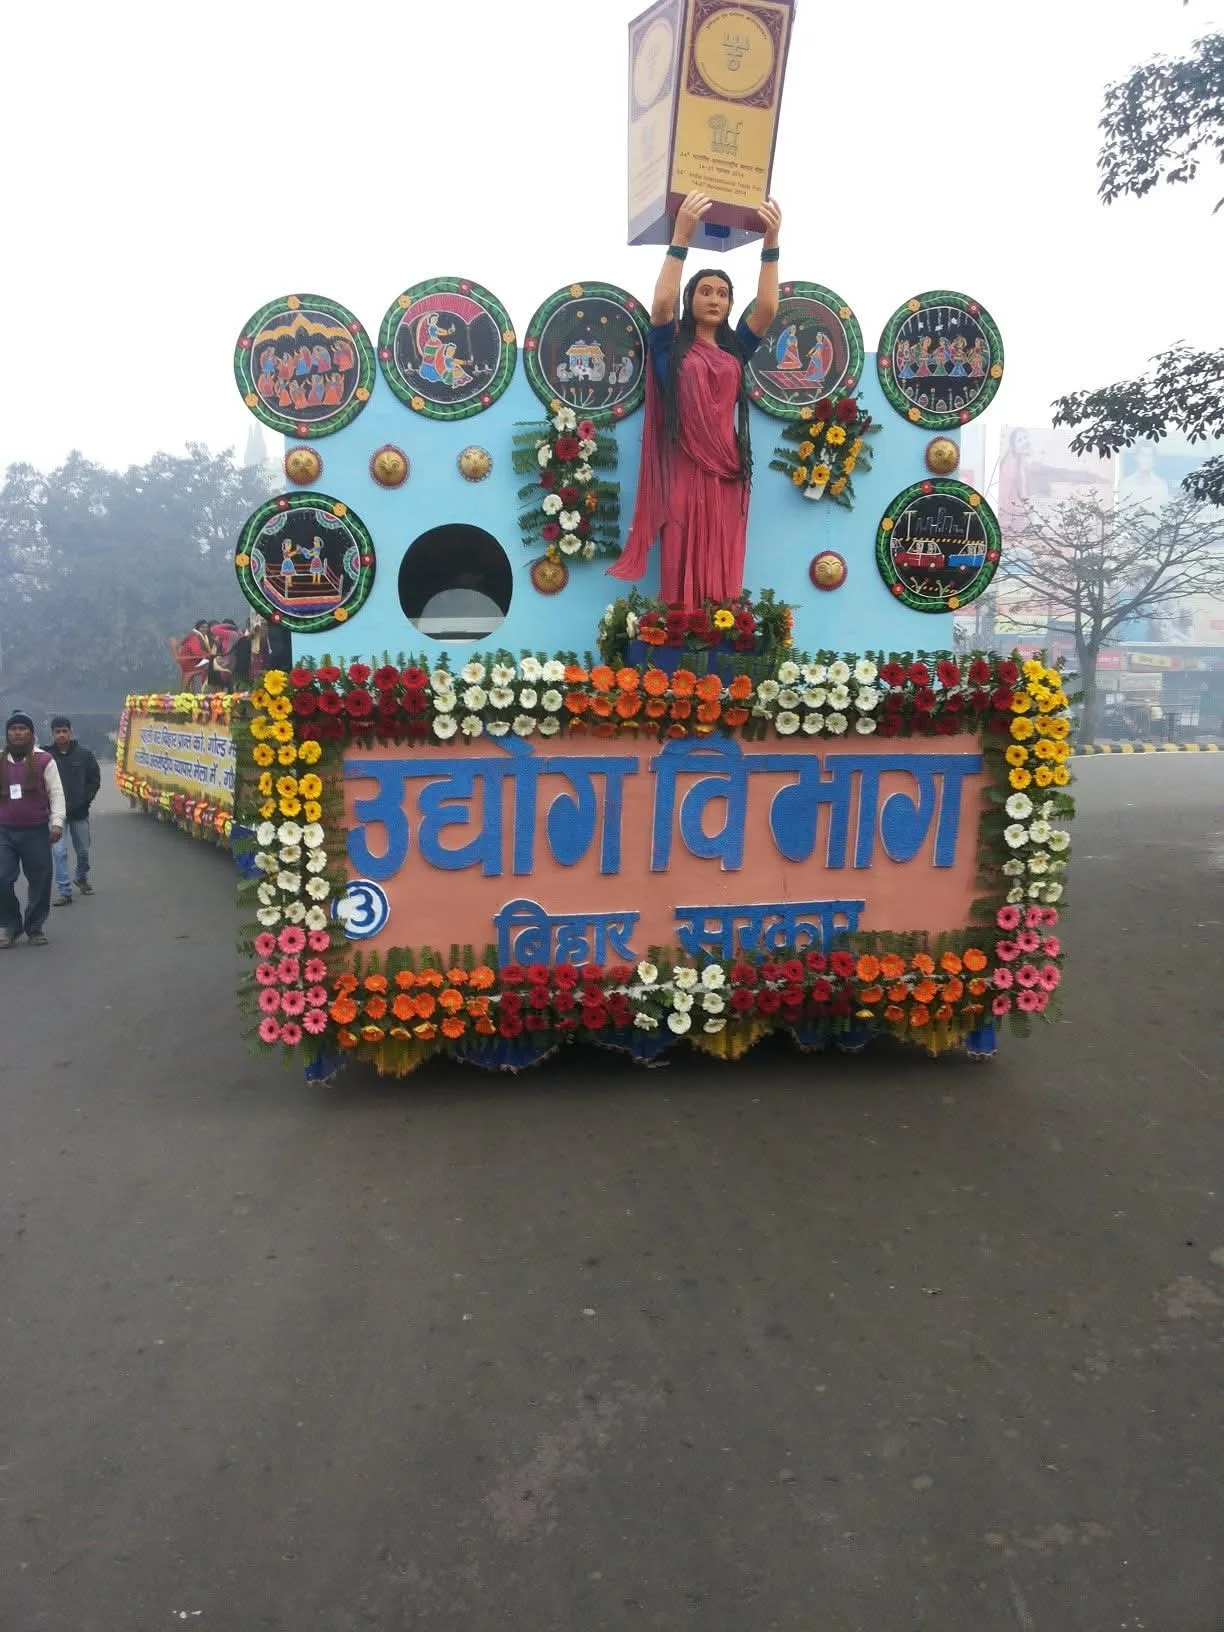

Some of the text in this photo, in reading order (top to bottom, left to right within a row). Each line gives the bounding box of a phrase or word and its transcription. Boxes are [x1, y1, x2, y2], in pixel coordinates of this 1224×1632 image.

[344, 731, 982, 880] उद्योग विभाग
[493, 898, 640, 967] बिहार
